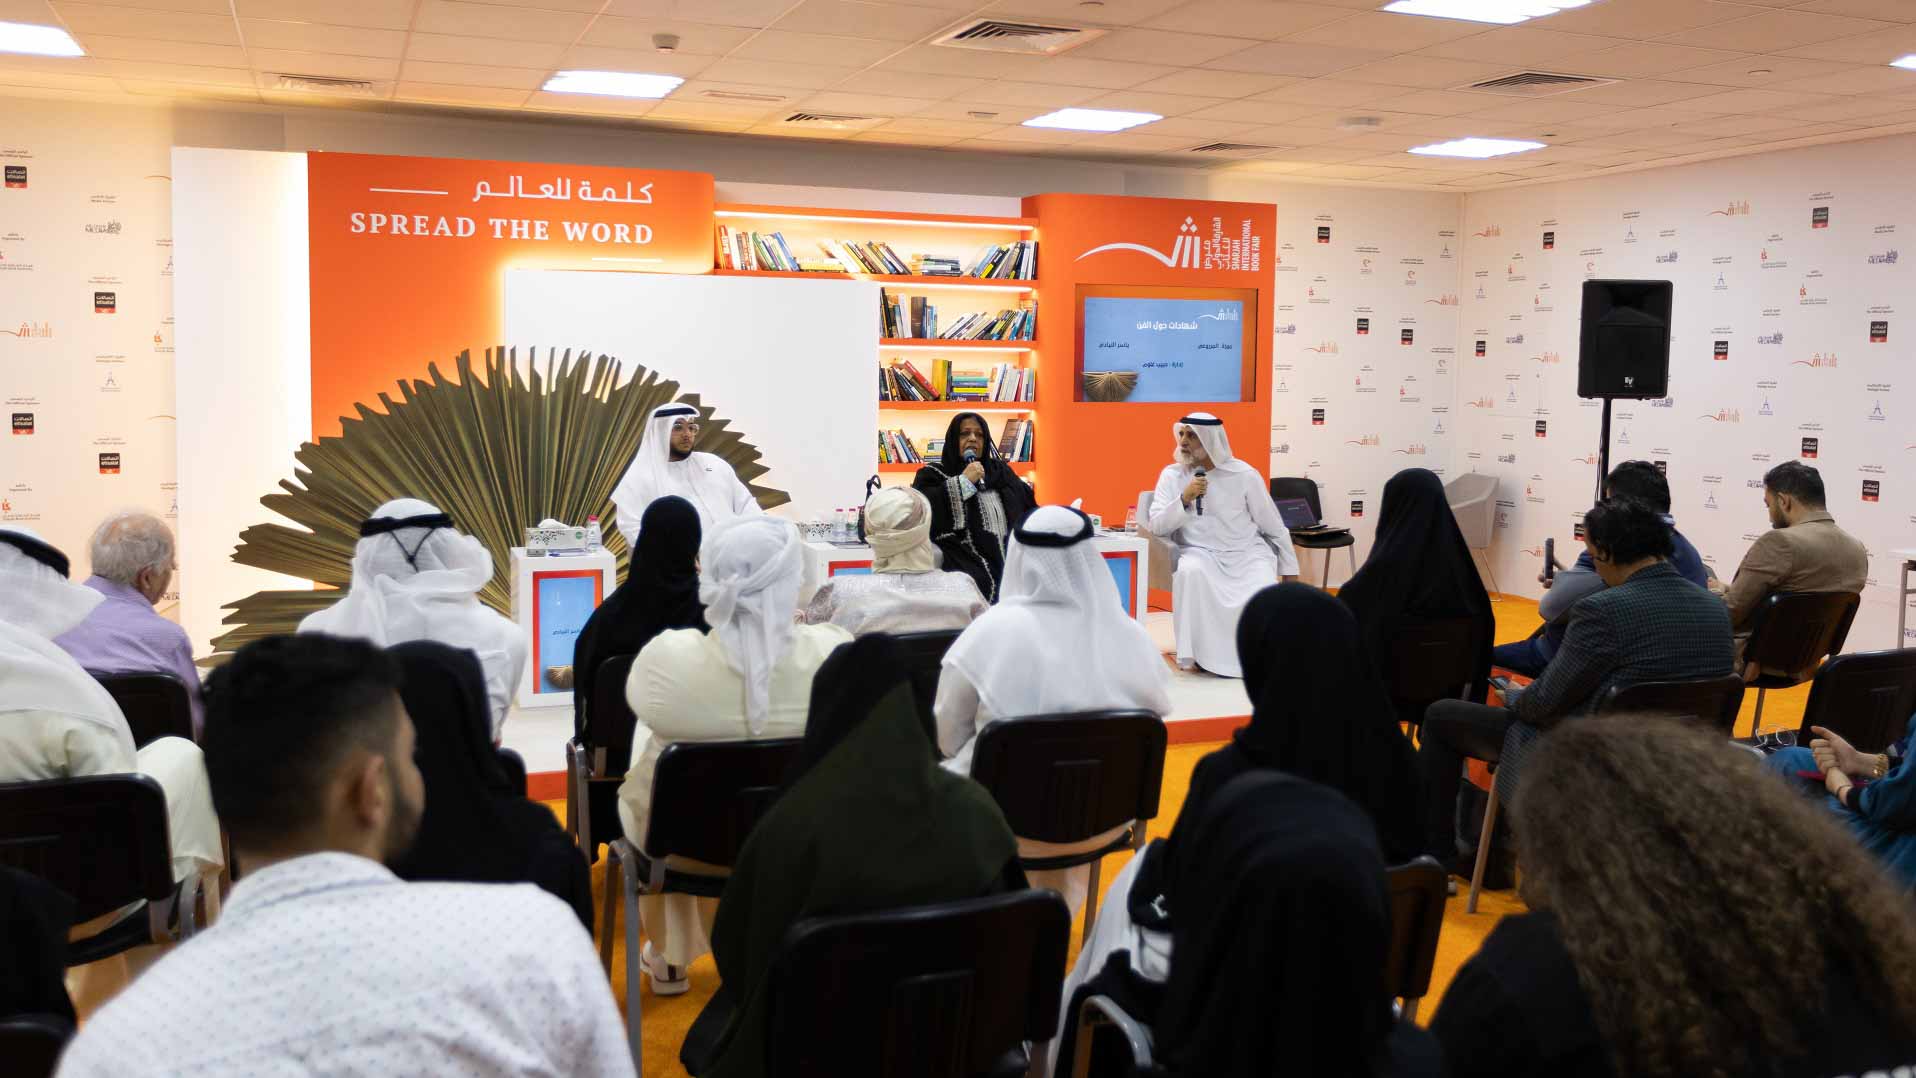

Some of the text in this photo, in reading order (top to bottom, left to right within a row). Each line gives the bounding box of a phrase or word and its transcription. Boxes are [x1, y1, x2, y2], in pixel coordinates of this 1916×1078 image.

[472, 175, 654, 204] كلمة للعالم
[350, 211, 653, 245] SPREAD THE WORD
[1231, 239, 1241, 271] SHARJAH
[1241, 218, 1252, 271] INTERNATIONAL
[1250, 235, 1261, 272] BOOK FAIR
[1152, 320, 1168, 331] حول
[1168, 320, 1199, 330] شهادات
